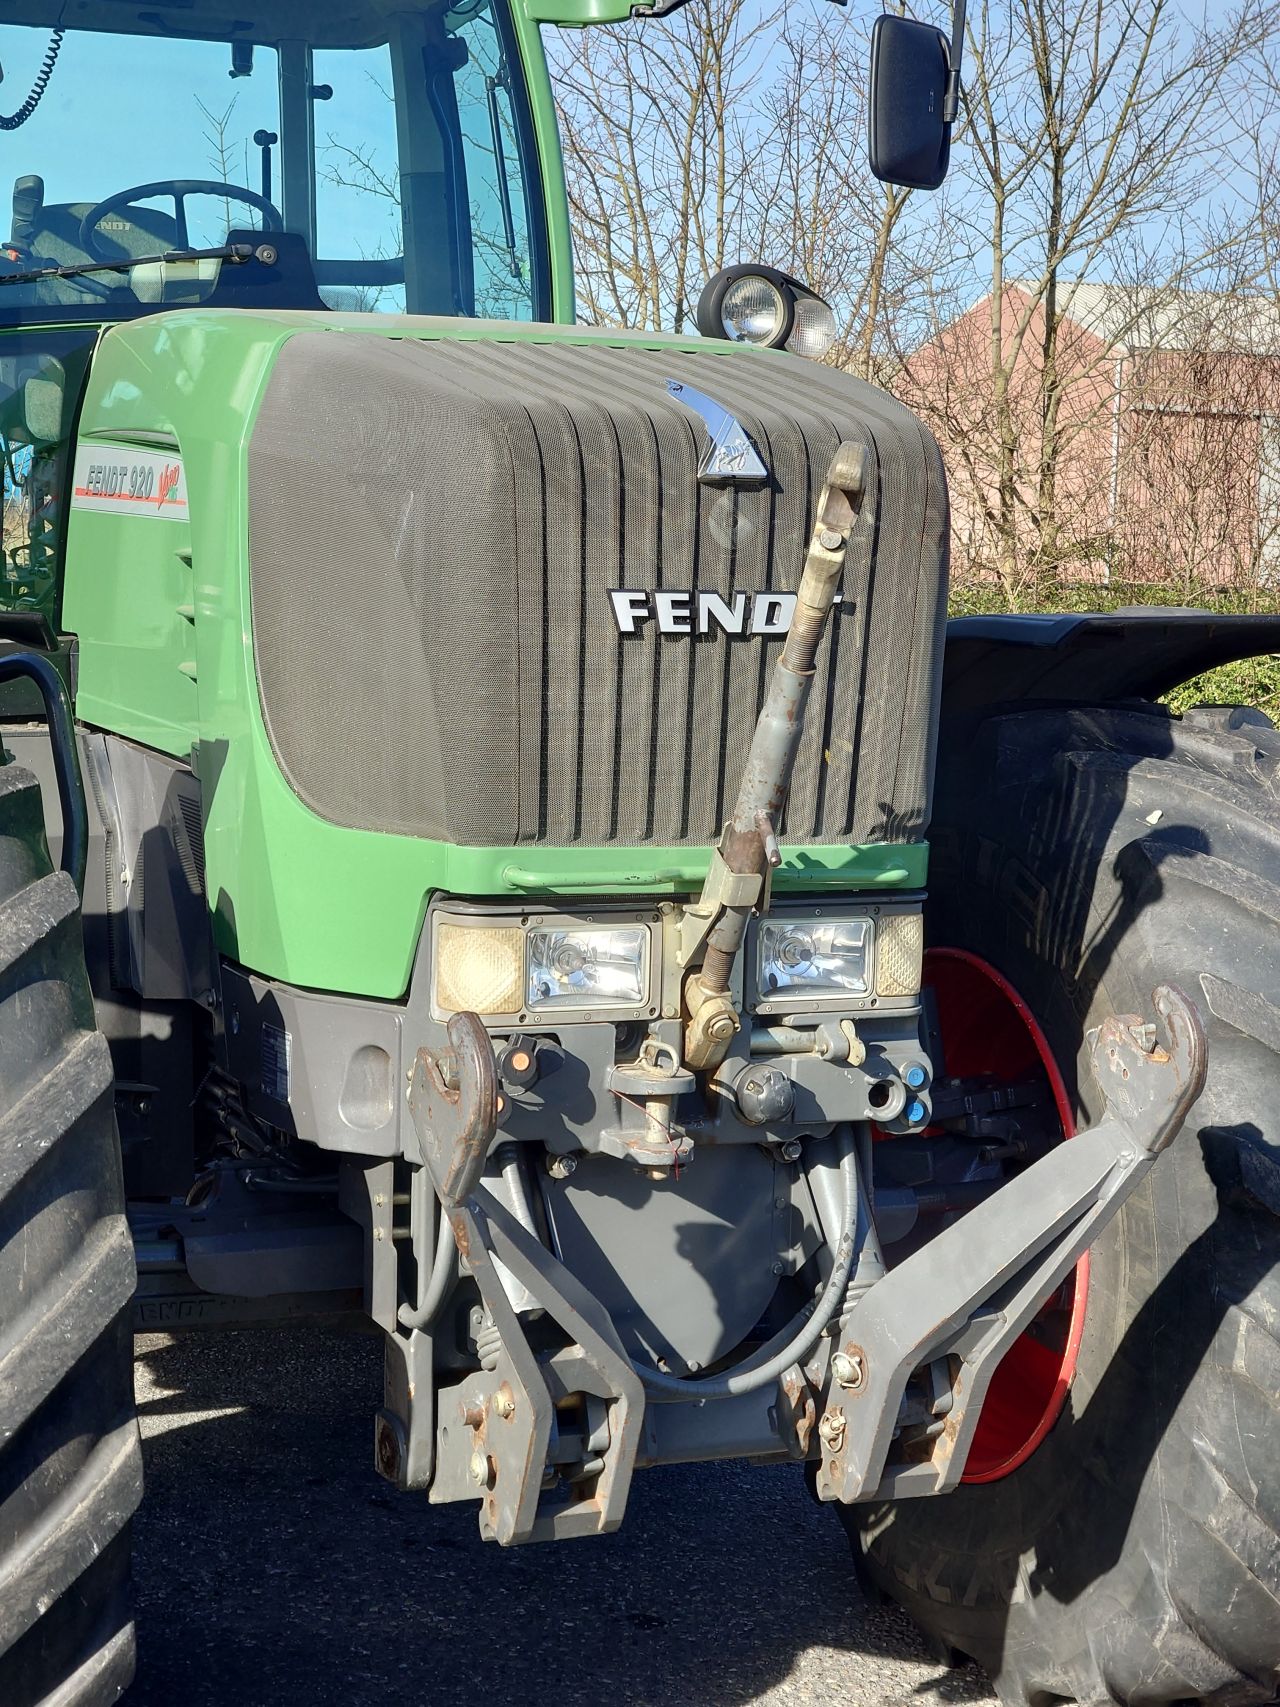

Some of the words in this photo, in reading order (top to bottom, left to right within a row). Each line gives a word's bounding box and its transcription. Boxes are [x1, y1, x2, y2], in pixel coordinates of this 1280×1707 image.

[94, 221, 133, 231] ENDT
[86, 465, 128, 497] FENDT
[128, 465, 154, 500] 920
[608, 589, 843, 634] FEND
